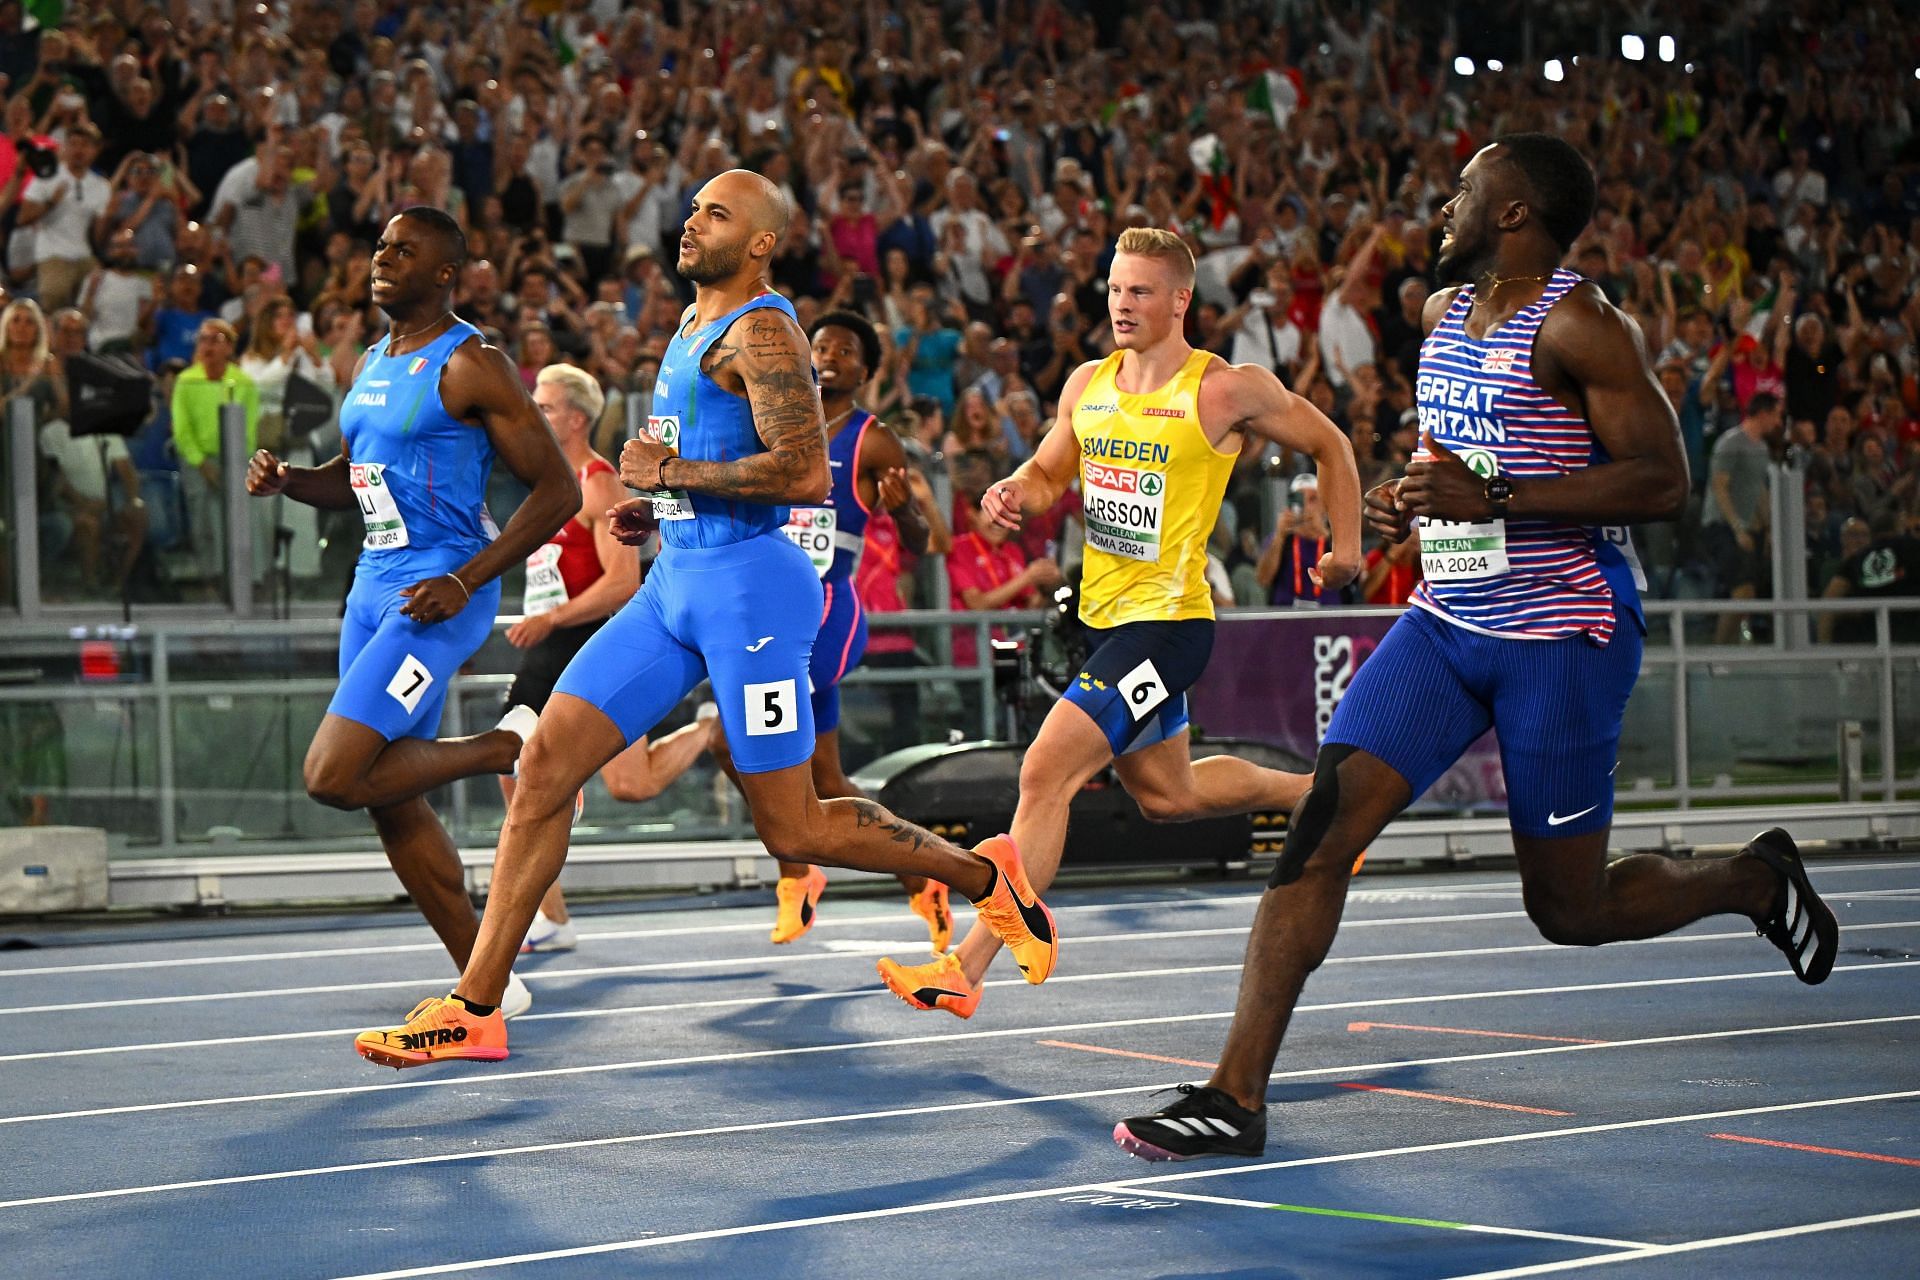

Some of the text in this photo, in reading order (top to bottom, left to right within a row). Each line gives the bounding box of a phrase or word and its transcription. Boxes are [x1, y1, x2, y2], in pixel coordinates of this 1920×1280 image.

[1416, 375, 1503, 413] GREAT
[1143, 408, 1185, 418] BAUHAUS
[1417, 406, 1506, 443] BRITAIN
[1083, 437, 1170, 464] SWEDEN
[1085, 462, 1136, 491] SPAR
[360, 494, 377, 515] LI
[1084, 495, 1157, 529] LARSSON
[1090, 532, 1145, 556] ROMA 2024
[1110, 527, 1137, 540] CLEAN
[1421, 539, 1473, 552] UN CLEAN
[1424, 556, 1489, 573] MA 2024
[401, 668, 425, 698] 7
[1131, 681, 1157, 705] 6
[764, 690, 783, 728] 5
[393, 1026, 468, 1050] NITRO
